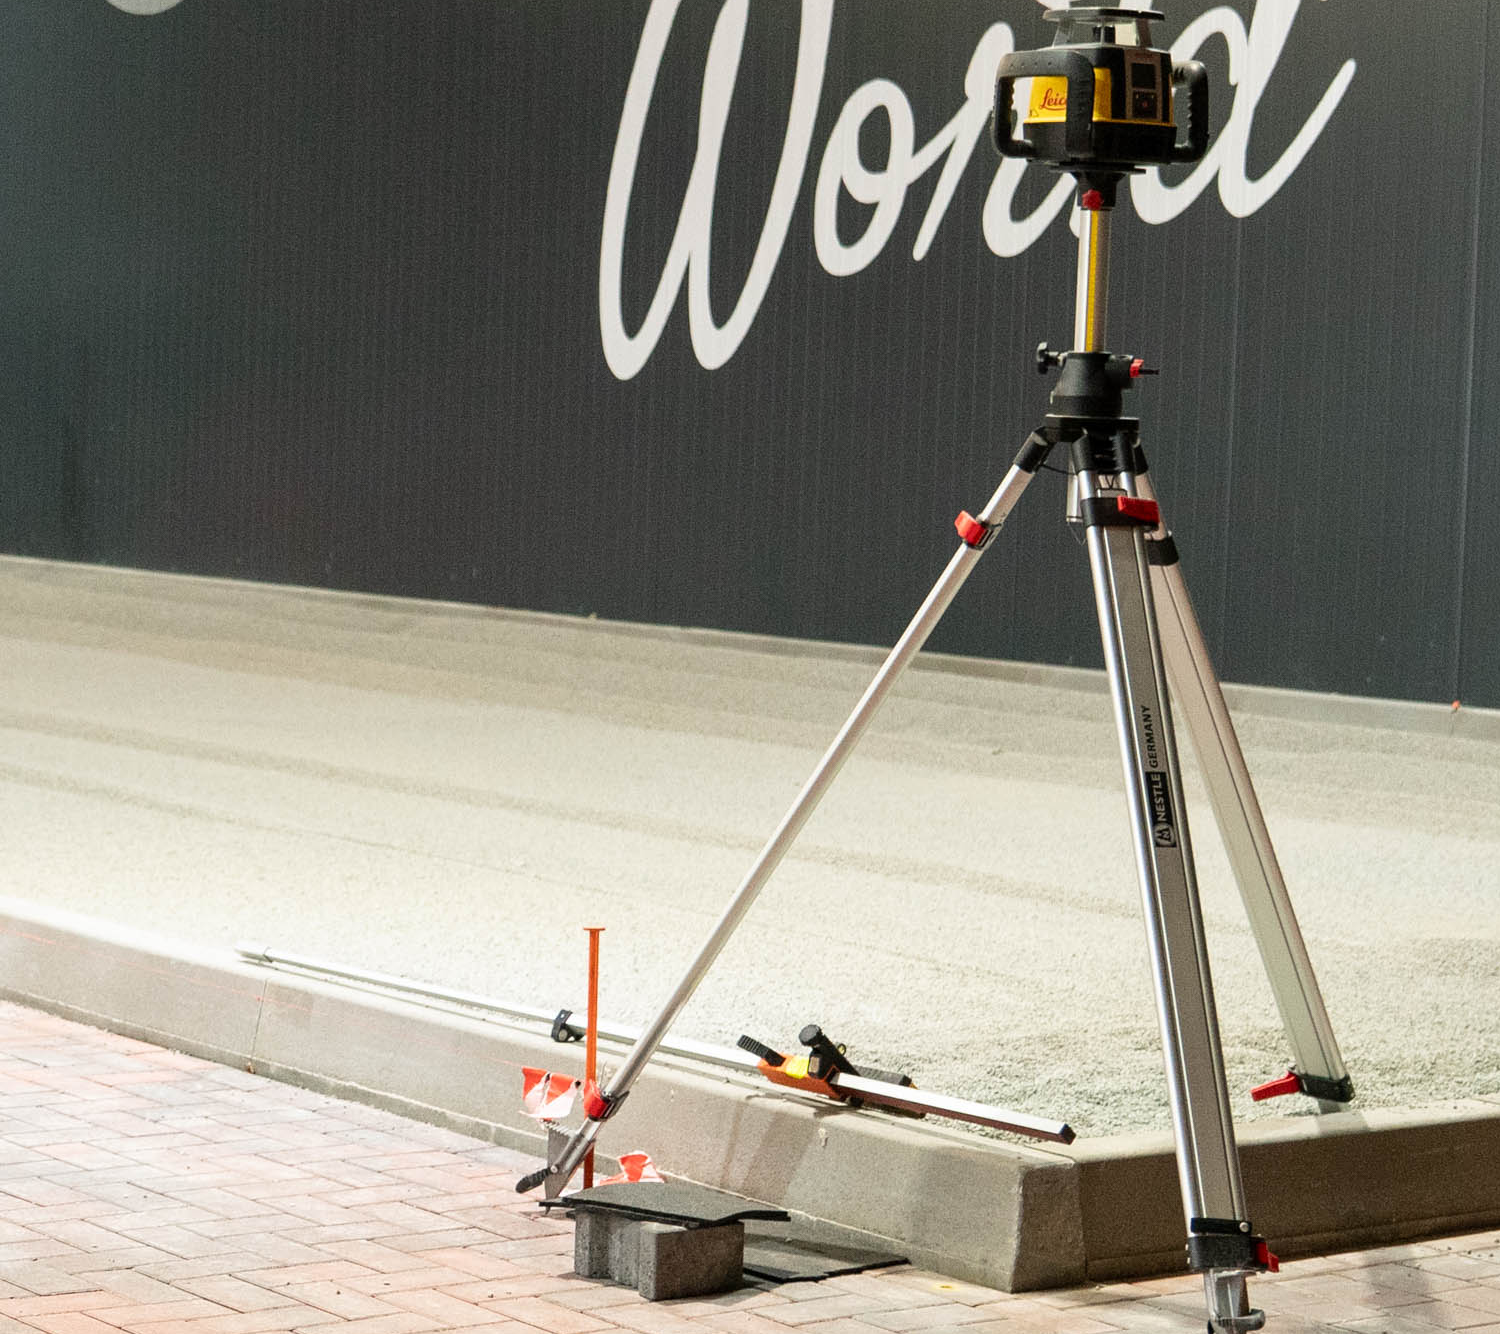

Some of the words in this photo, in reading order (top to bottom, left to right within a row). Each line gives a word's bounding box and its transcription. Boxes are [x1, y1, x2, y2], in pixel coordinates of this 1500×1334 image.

[1040, 88, 1067, 111] Leic
[1141, 705, 1159, 768] GERMANY
[1151, 773, 1166, 822] NESTLE
